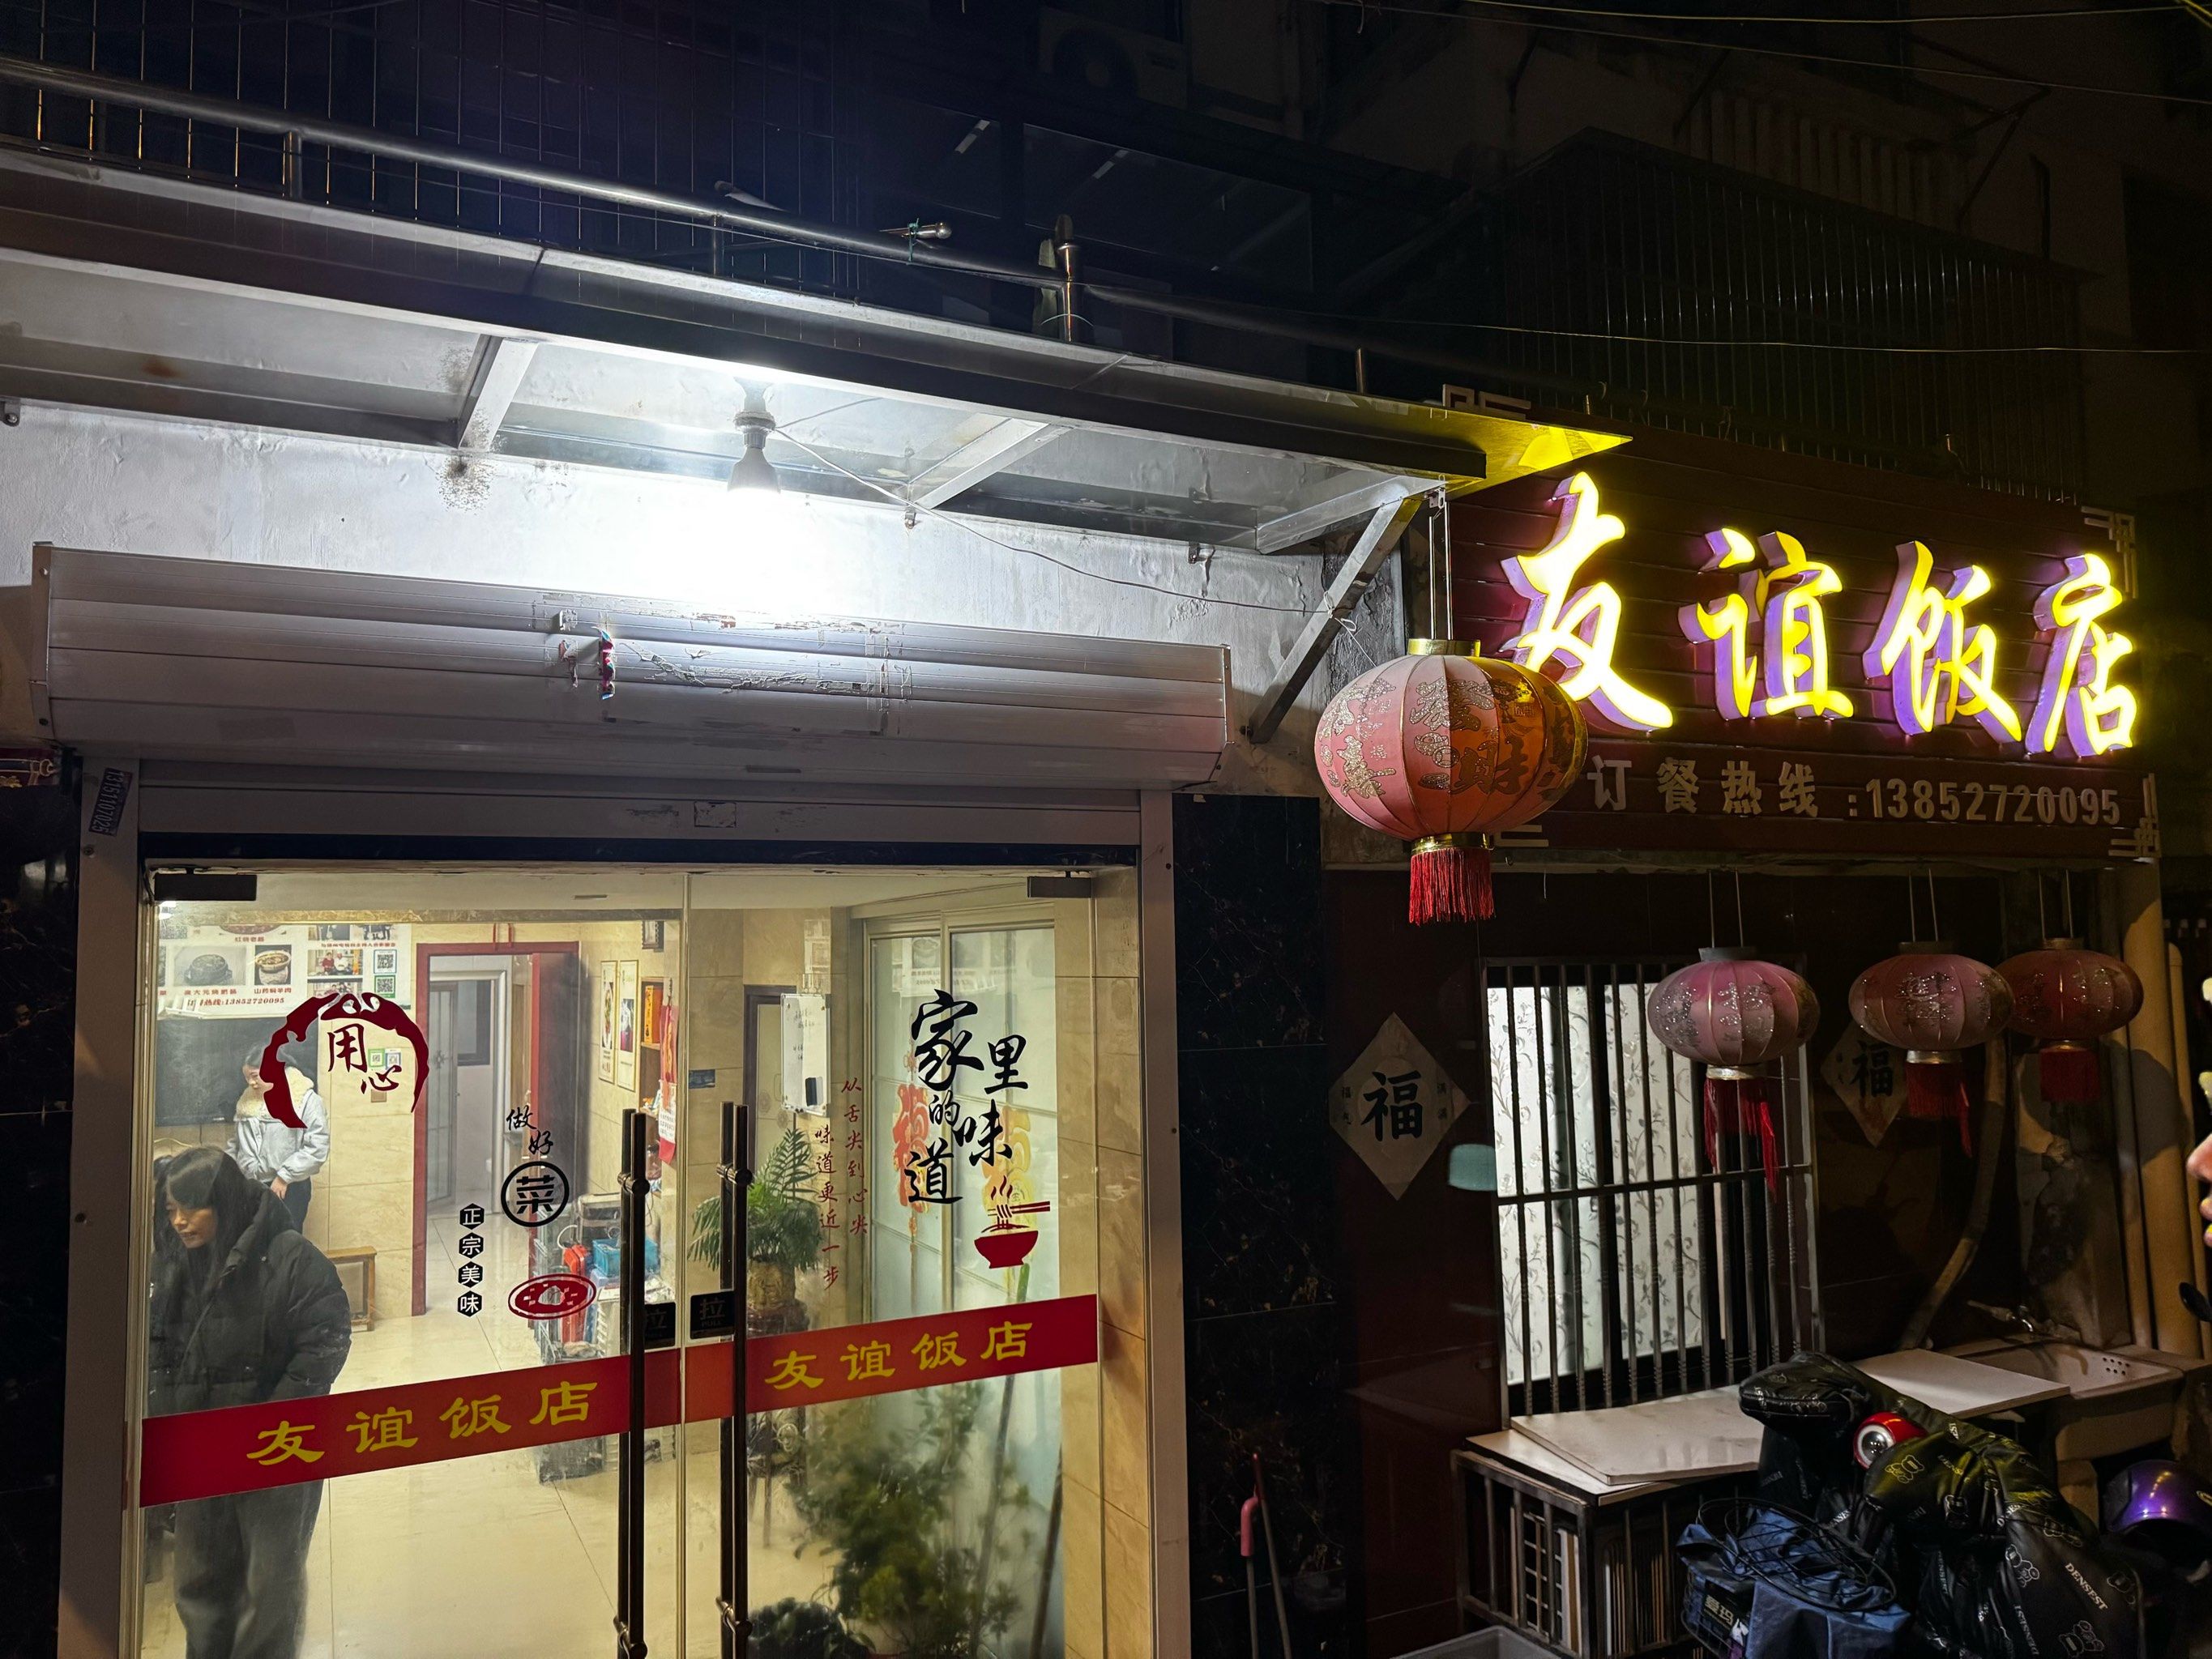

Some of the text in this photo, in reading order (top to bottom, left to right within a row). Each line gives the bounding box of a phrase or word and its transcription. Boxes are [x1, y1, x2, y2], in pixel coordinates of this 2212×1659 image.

[1501, 471, 2137, 757] 友谊饭店
[327, 1023, 402, 1094] 用心
[1850, 1040, 1894, 1099] 福
[506, 1105, 553, 1156] 做好
[1361, 1071, 1423, 1141] 福
[516, 1175, 555, 1214] 菜
[814, 1124, 840, 1290] 味道更近一步
[459, 1206, 483, 1314] 正宗美味
[765, 1321, 1033, 1390] 友谊饭店
[246, 1381, 598, 1465] 友谊饭店
[2064, 1562, 2109, 1611] DENSEST
